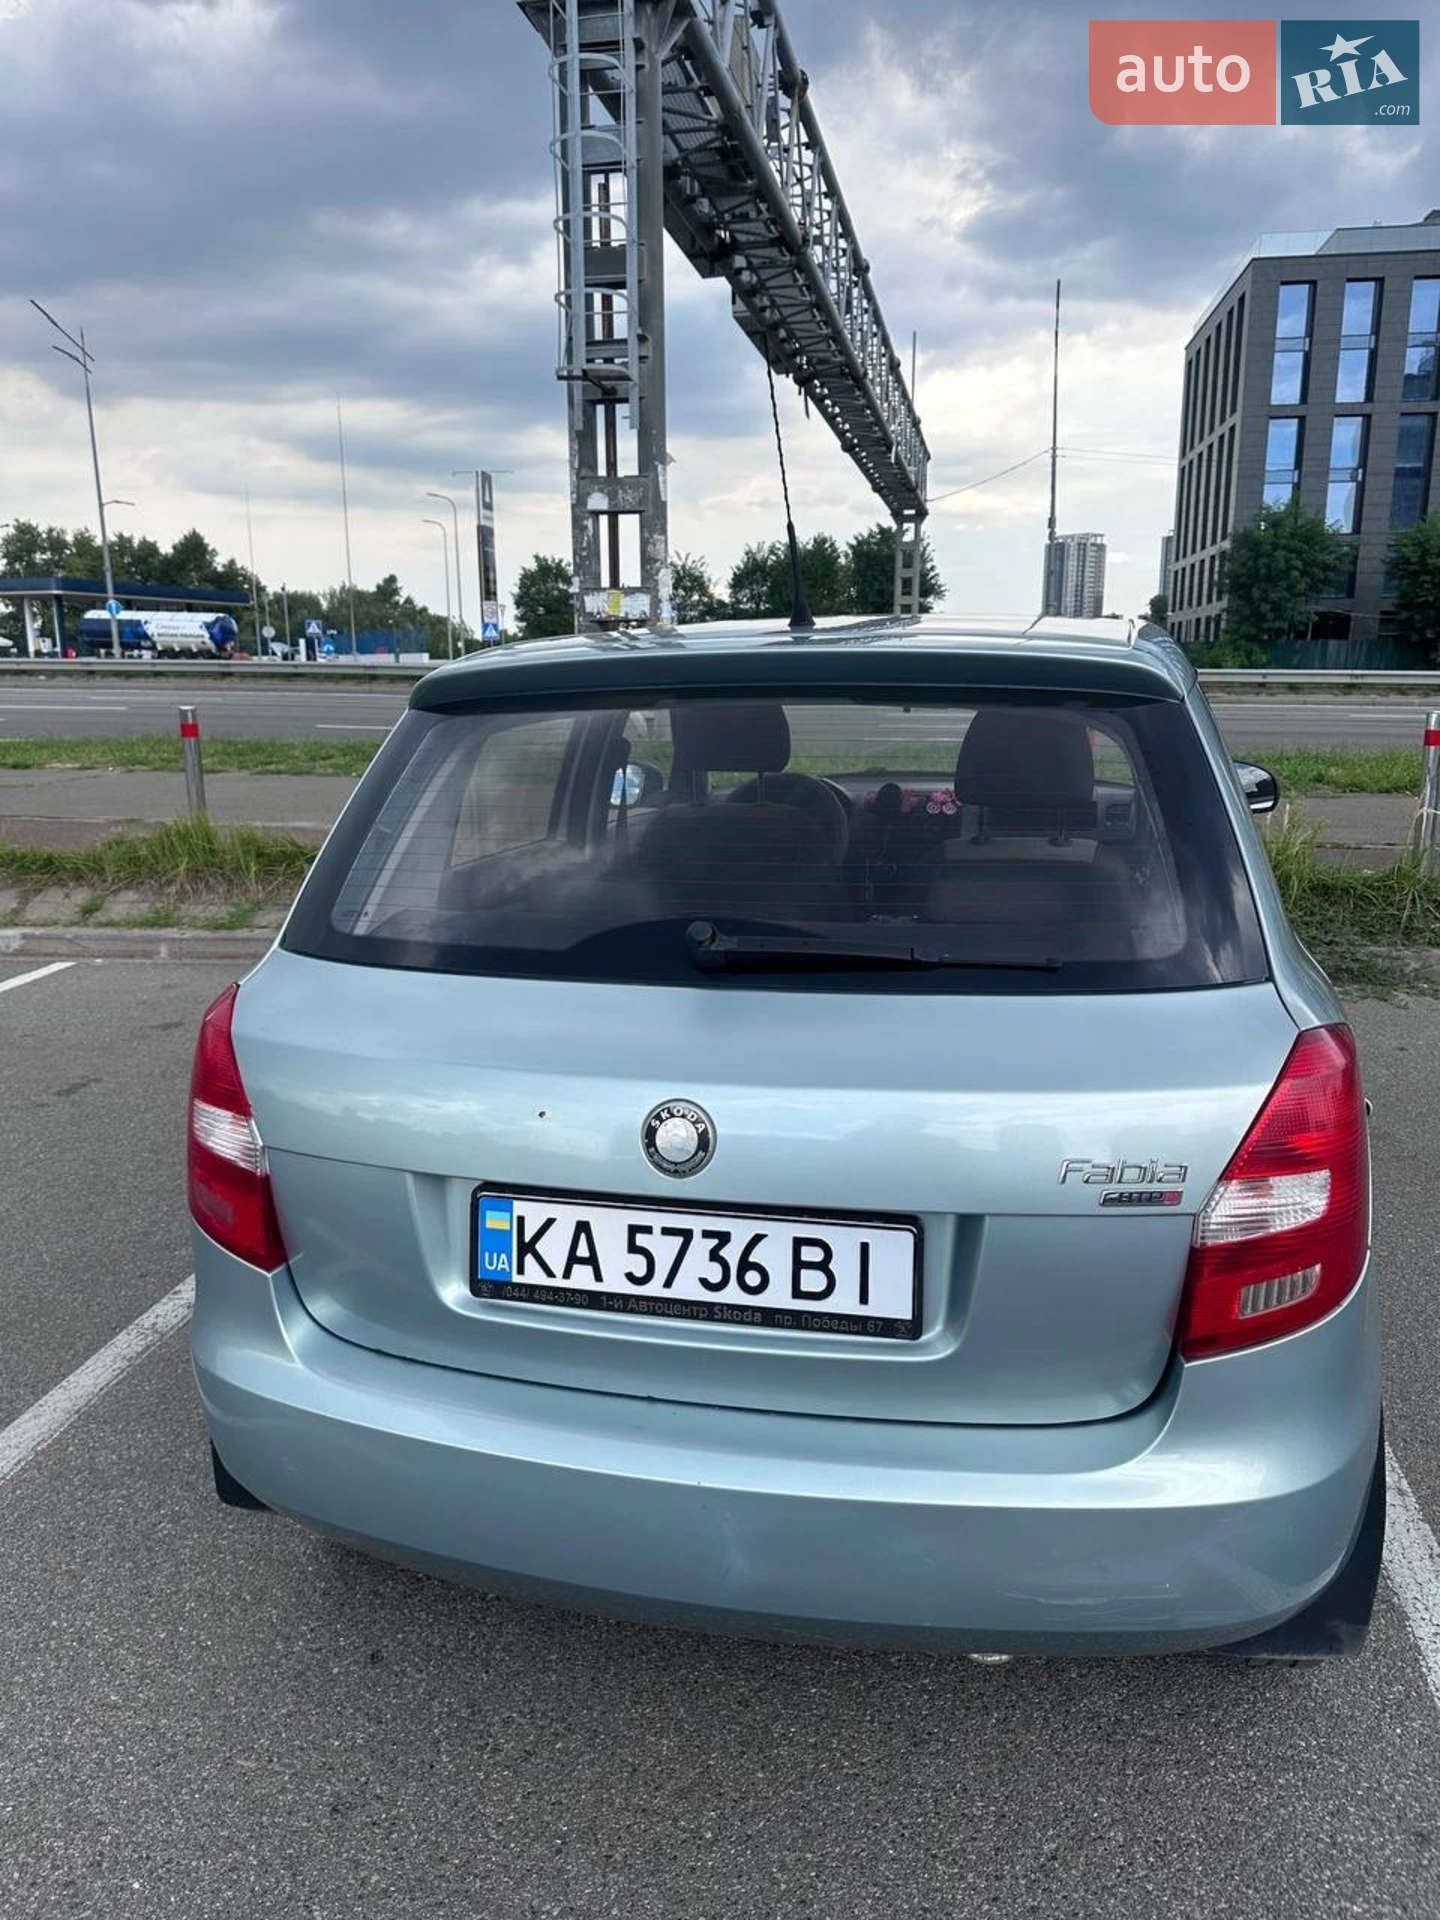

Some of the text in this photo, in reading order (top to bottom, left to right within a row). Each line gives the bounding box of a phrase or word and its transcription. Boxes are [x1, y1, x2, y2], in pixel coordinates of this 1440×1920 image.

[1059, 1157, 1189, 1186] Fabia
[485, 1251, 510, 1273] UA
[516, 1214, 870, 1306] KA 5736 BI
[627, 1297, 709, 1320] Автоцентр
[713, 1305, 762, 1323] Skoda
[774, 1314, 797, 1327] пр.
[802, 1314, 862, 1333] Победы
[867, 1320, 884, 1333] 67
